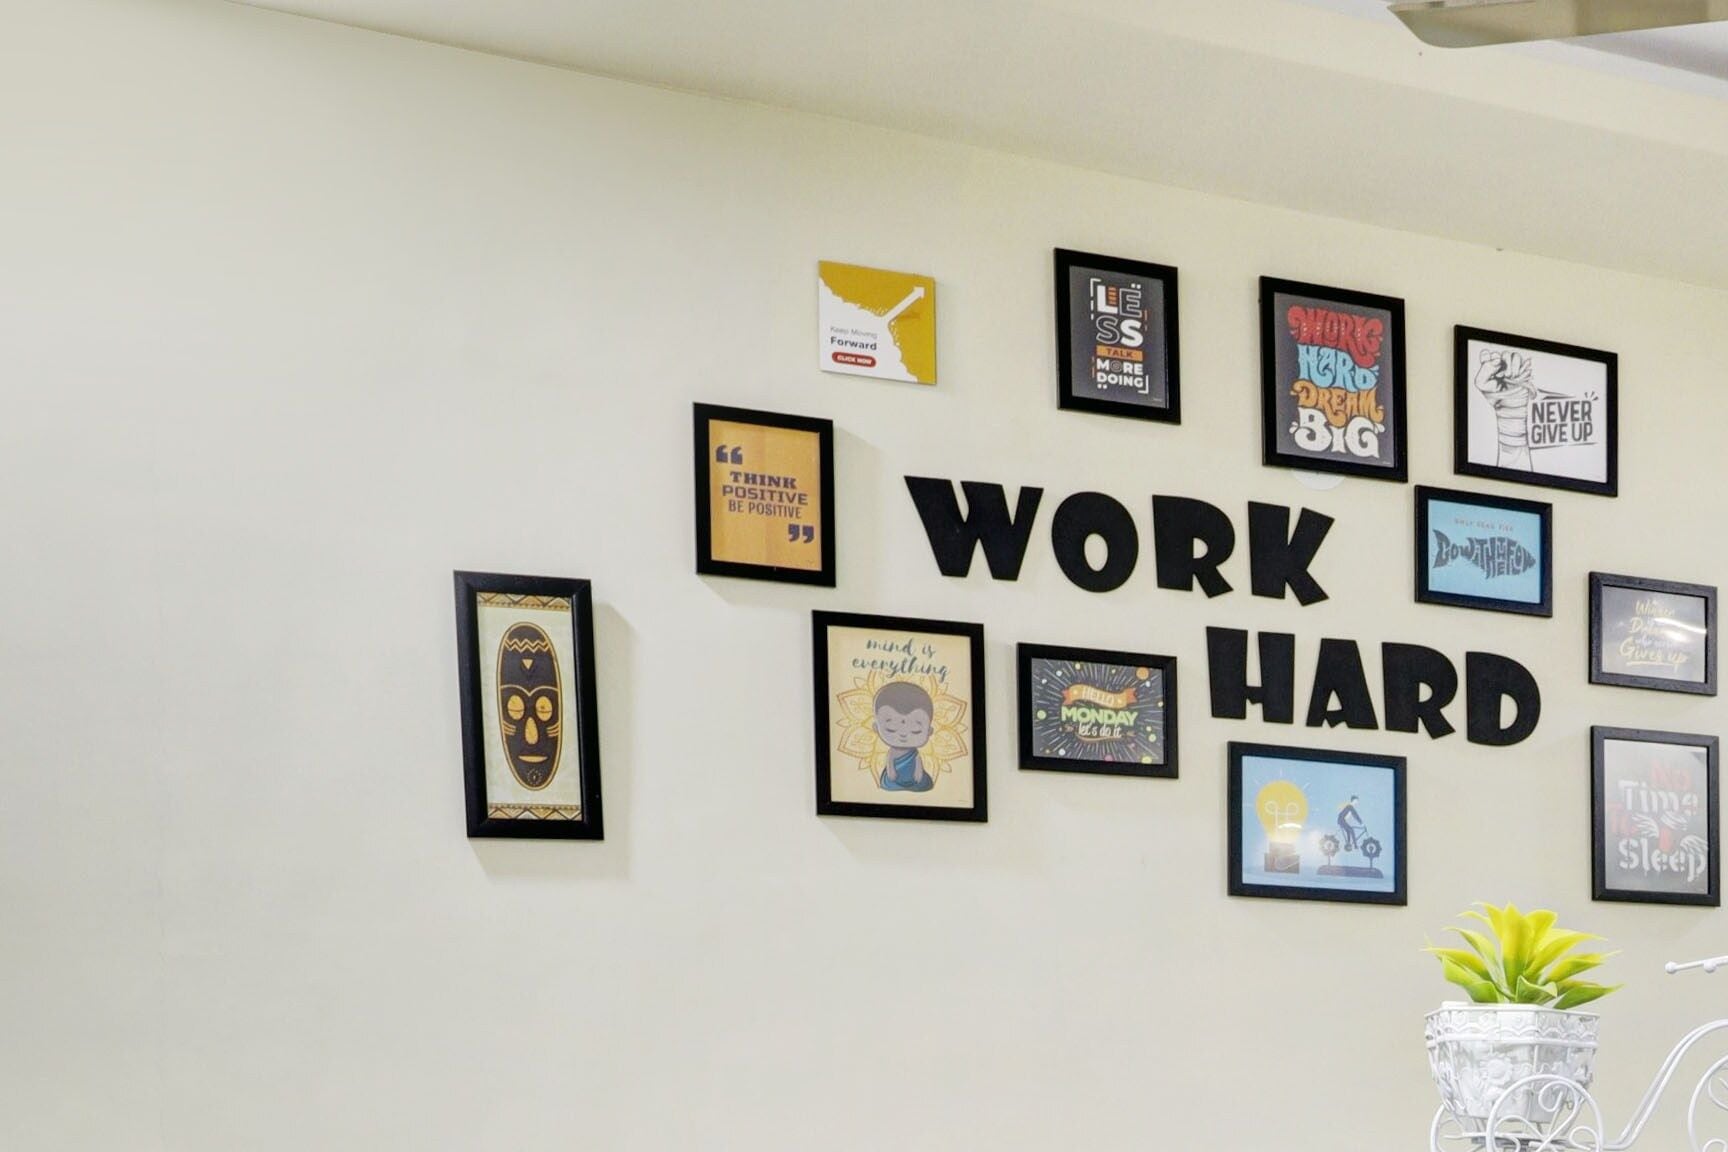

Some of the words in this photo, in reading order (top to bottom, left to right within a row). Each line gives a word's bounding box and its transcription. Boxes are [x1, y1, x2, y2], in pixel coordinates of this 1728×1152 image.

[830, 336, 877, 351] Forward
[851, 328, 878, 340] Moving
[1287, 305, 1384, 368] WORK
[837, 354, 856, 363] CLICK
[857, 356, 873, 366] NOW
[1107, 347, 1134, 359] TALK
[1096, 358, 1143, 376] MORE
[1097, 372, 1144, 388] DOING
[1293, 379, 1384, 428] DREAM
[1531, 400, 1592, 424] NEVER
[1294, 407, 1380, 458] BIG
[1531, 423, 1568, 445] GIVE
[1571, 422, 1593, 442] UP
[730, 471, 797, 489] THINK
[722, 485, 809, 506] POSITIVE
[729, 500, 744, 513] BE
[748, 502, 802, 519] POSITIVE
[904, 475, 1335, 606] WORK
[866, 637, 914, 657] mind
[922, 643, 936, 658] is
[852, 656, 949, 683] everything
[1081, 686, 1115, 706] HELLO
[1206, 626, 1541, 746] HARD
[1061, 706, 1138, 726] MONDAY
[1099, 724, 1112, 737] do
[1113, 724, 1122, 738] it
[1618, 780, 1699, 817] Time
[1618, 837, 1707, 882] Sleep
